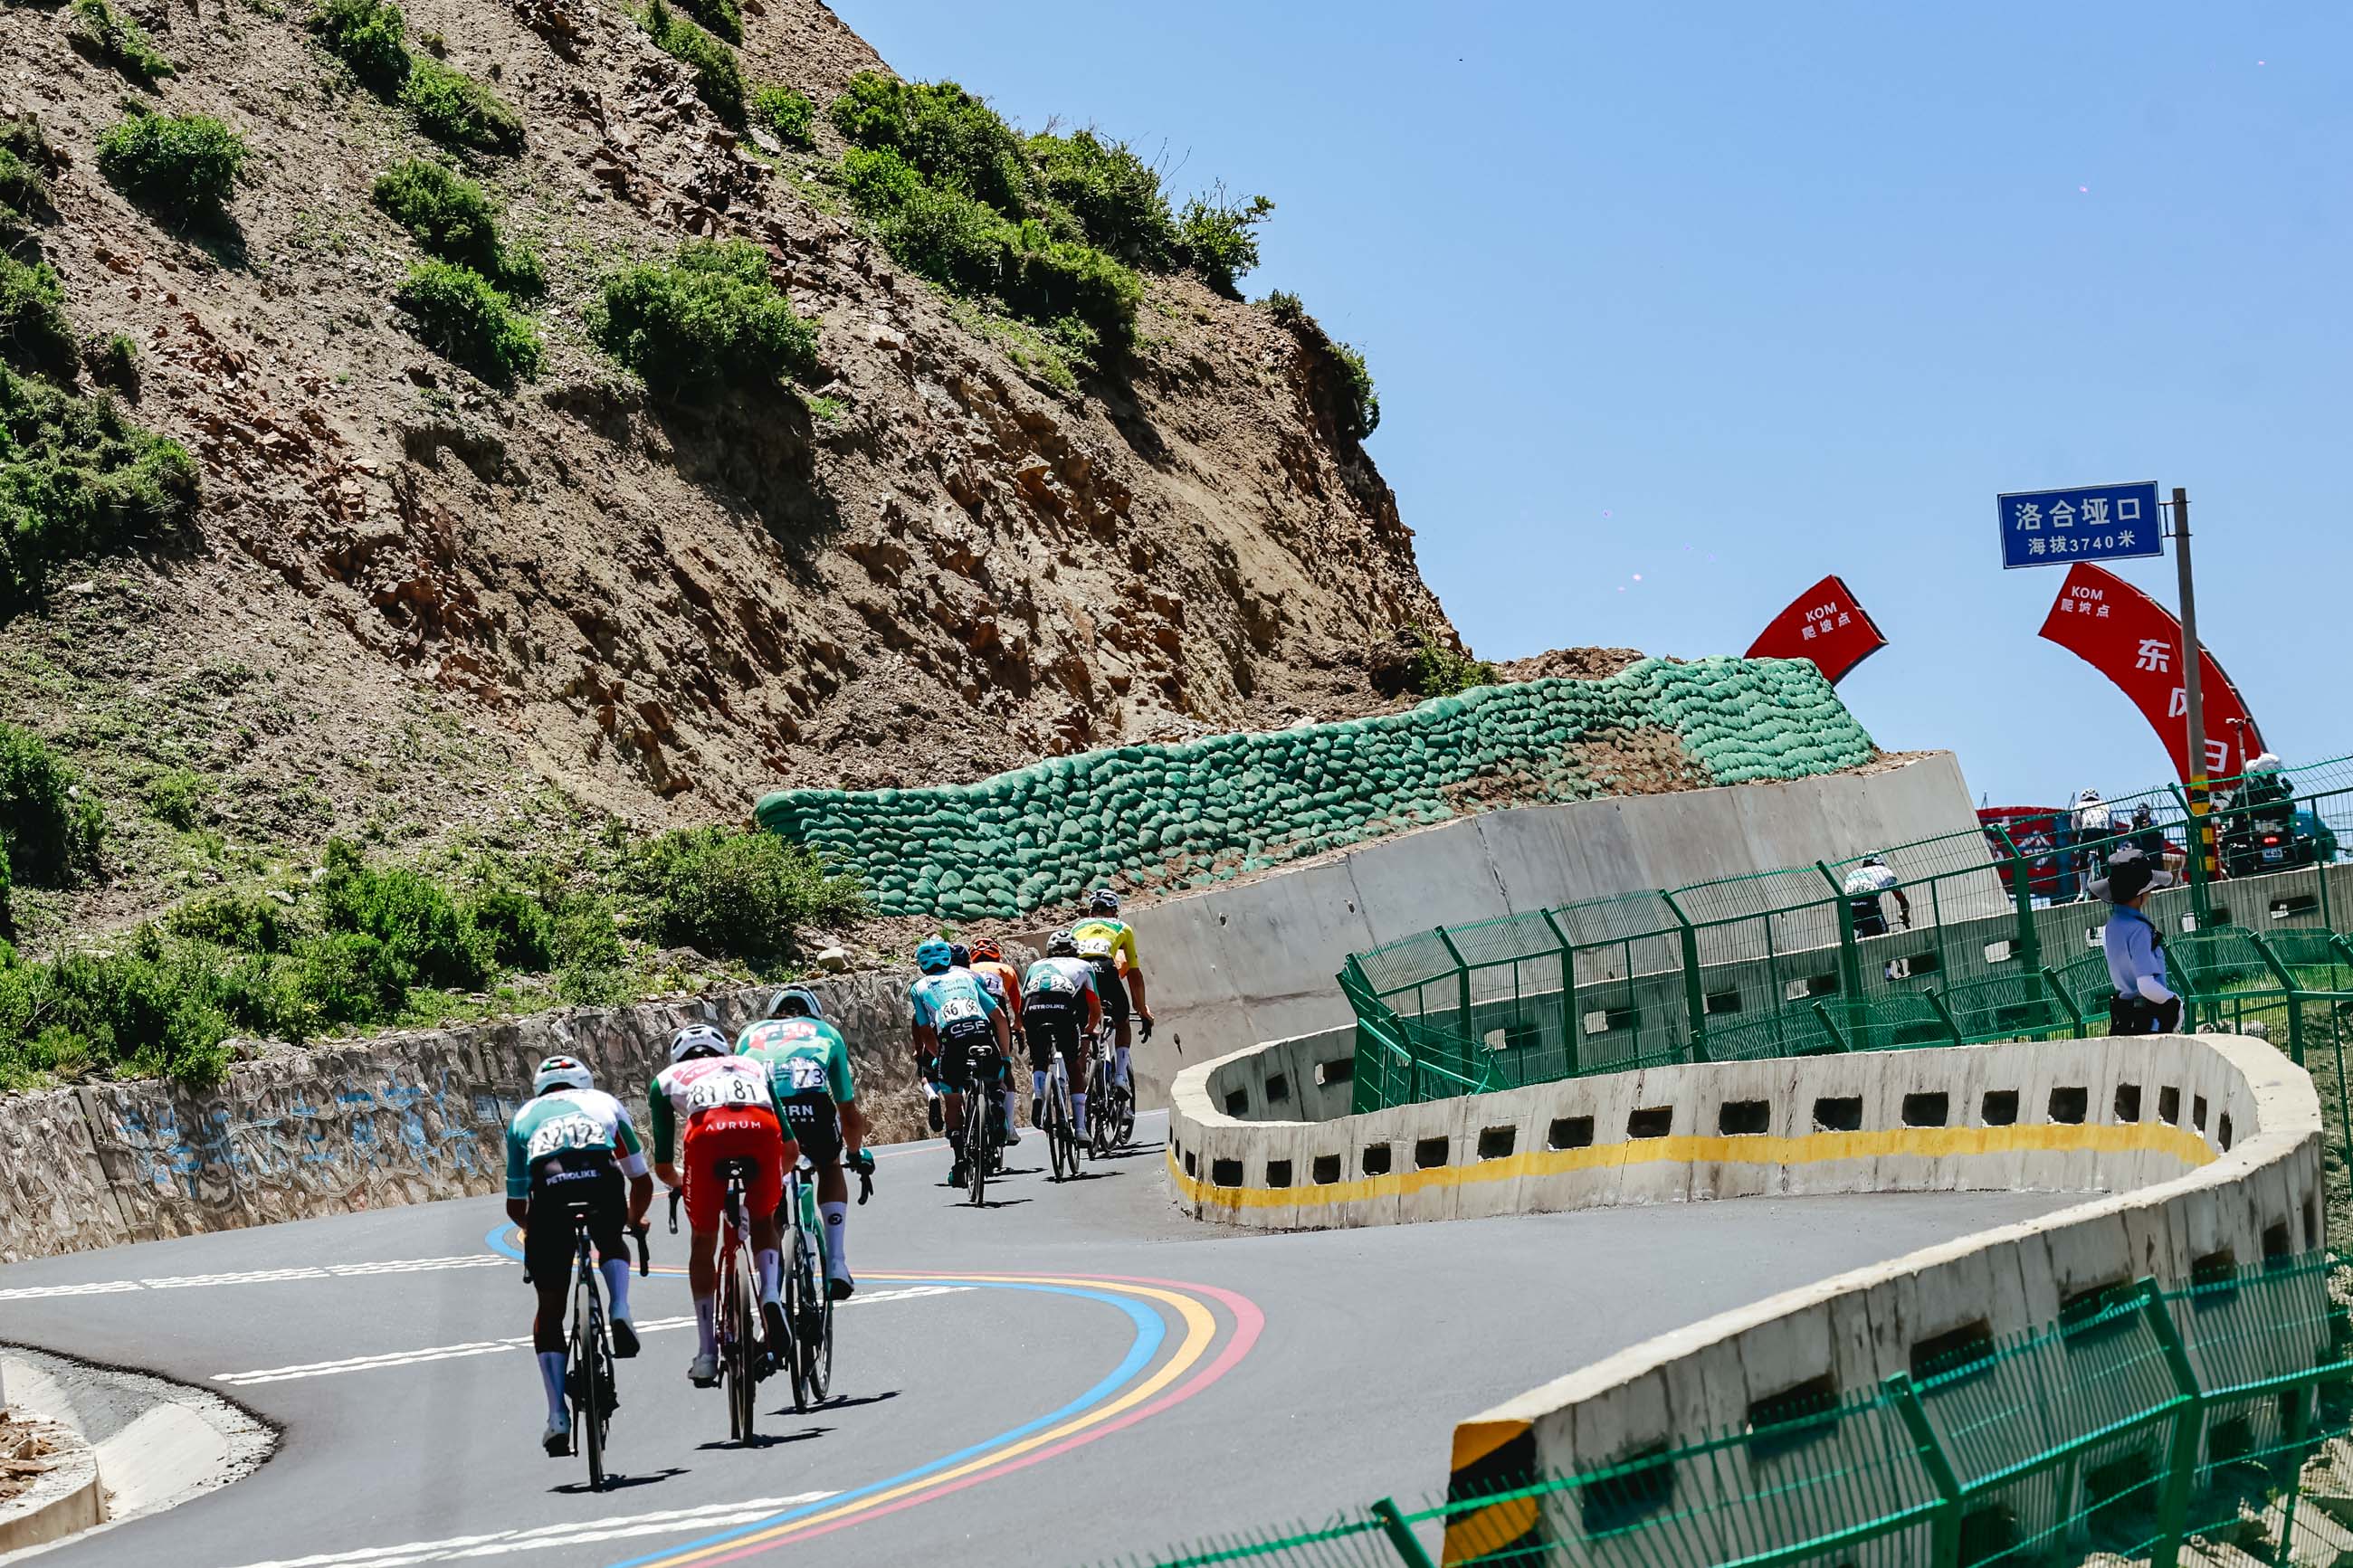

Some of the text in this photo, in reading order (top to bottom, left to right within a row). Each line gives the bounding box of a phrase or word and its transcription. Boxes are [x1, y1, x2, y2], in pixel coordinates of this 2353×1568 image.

[2015, 498, 2141, 531] 洛合垭口
[2028, 529, 2136, 556] 海拔3740米
[2072, 586, 2104, 602] KOM
[1805, 601, 1838, 622] KOM
[2061, 598, 2110, 618] 爬坡点
[1801, 612, 1852, 641] 爬坡点
[950, 1020, 986, 1034] CSF
[795, 1069, 824, 1087] 73
[692, 1079, 757, 1105] 81 81
[782, 1105, 814, 1117] RN
[705, 1121, 762, 1132] AURUM
[546, 1169, 597, 1187] PETROLIKE
